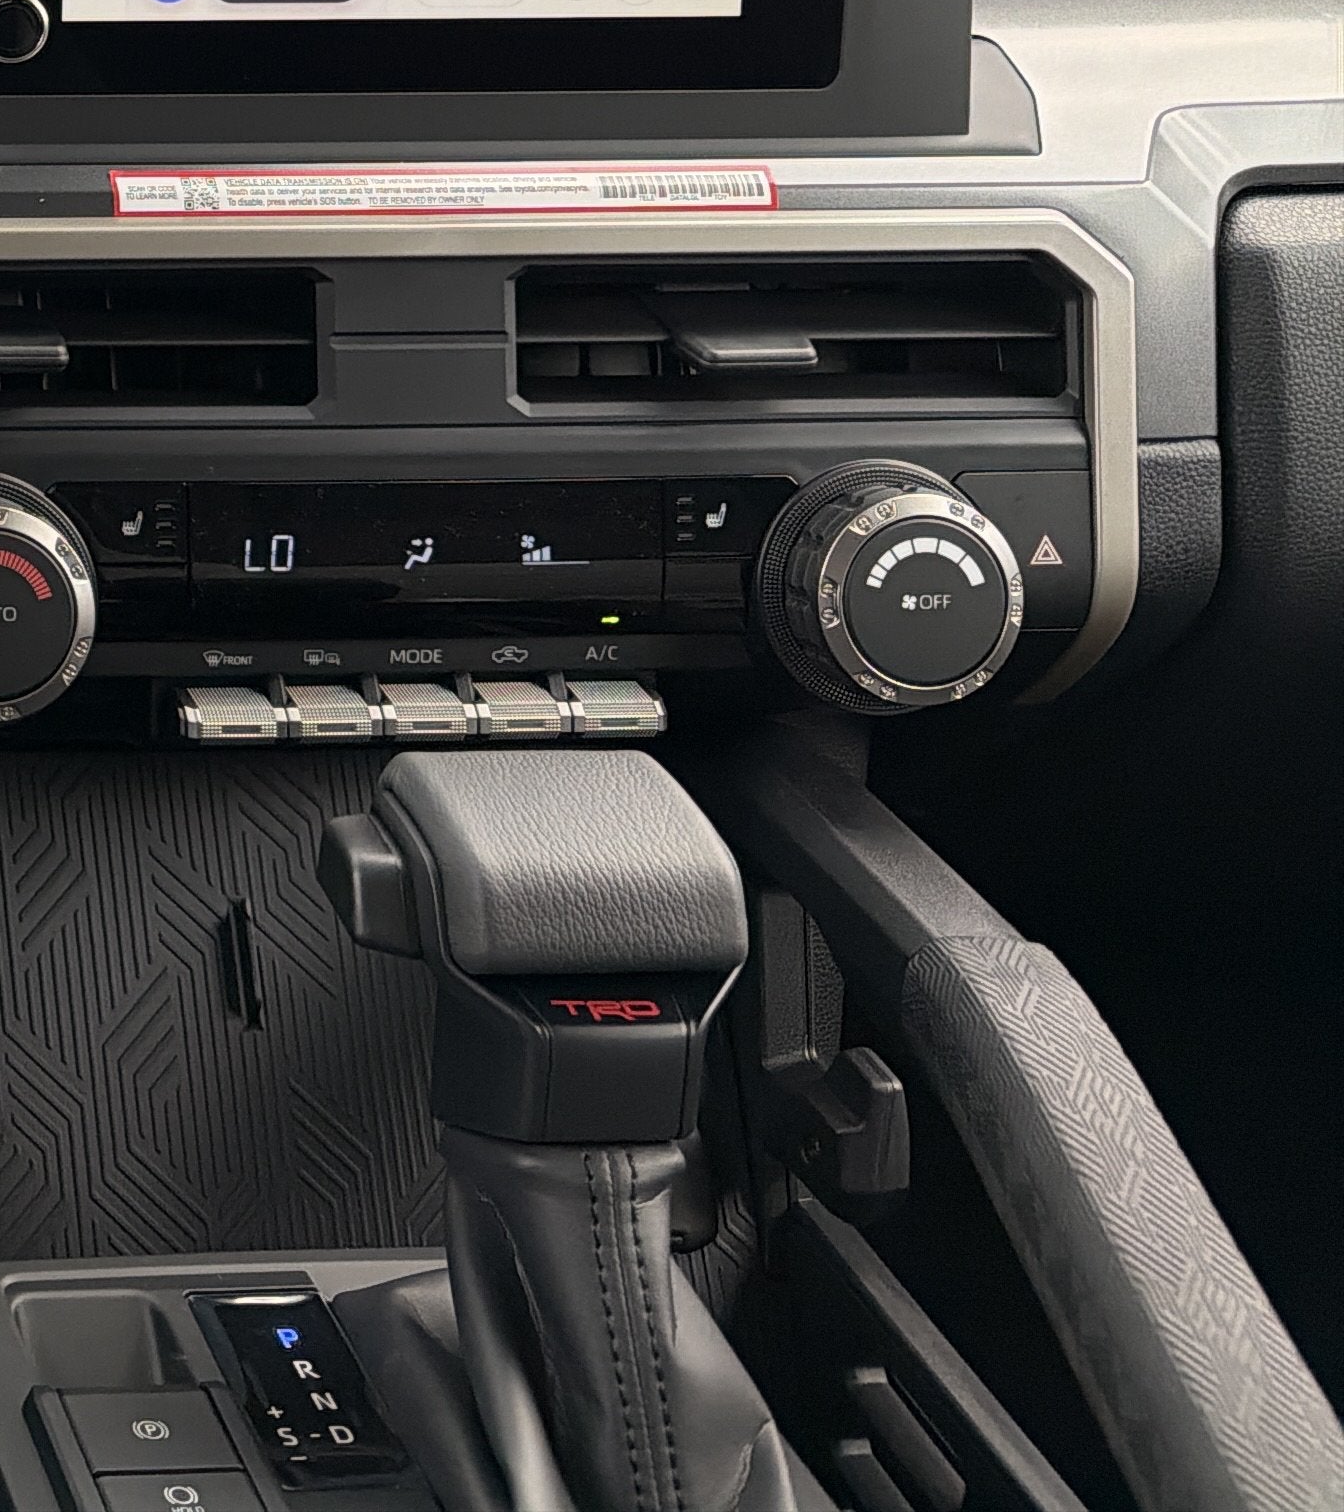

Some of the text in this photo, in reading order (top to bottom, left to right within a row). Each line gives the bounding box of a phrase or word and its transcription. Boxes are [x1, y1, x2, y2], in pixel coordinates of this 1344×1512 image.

[228, 197, 236, 207] To
[266, 199, 286, 207] press
[319, 197, 337, 206] SOS
[369, 195, 485, 205] TO BE REMOVED BY OWNER ONLY
[244, 534, 295, 573] LO
[919, 593, 952, 611] OFF
[222, 654, 254, 666] FRONT
[389, 647, 443, 665] MODE
[585, 644, 619, 662] A/C
[550, 999, 661, 1022] TRD
[275, 1327, 300, 1349] P
[292, 1359, 321, 1379] R
[310, 1391, 339, 1411] N
[277, 1427, 299, 1446] S
[329, 1425, 355, 1445] D
